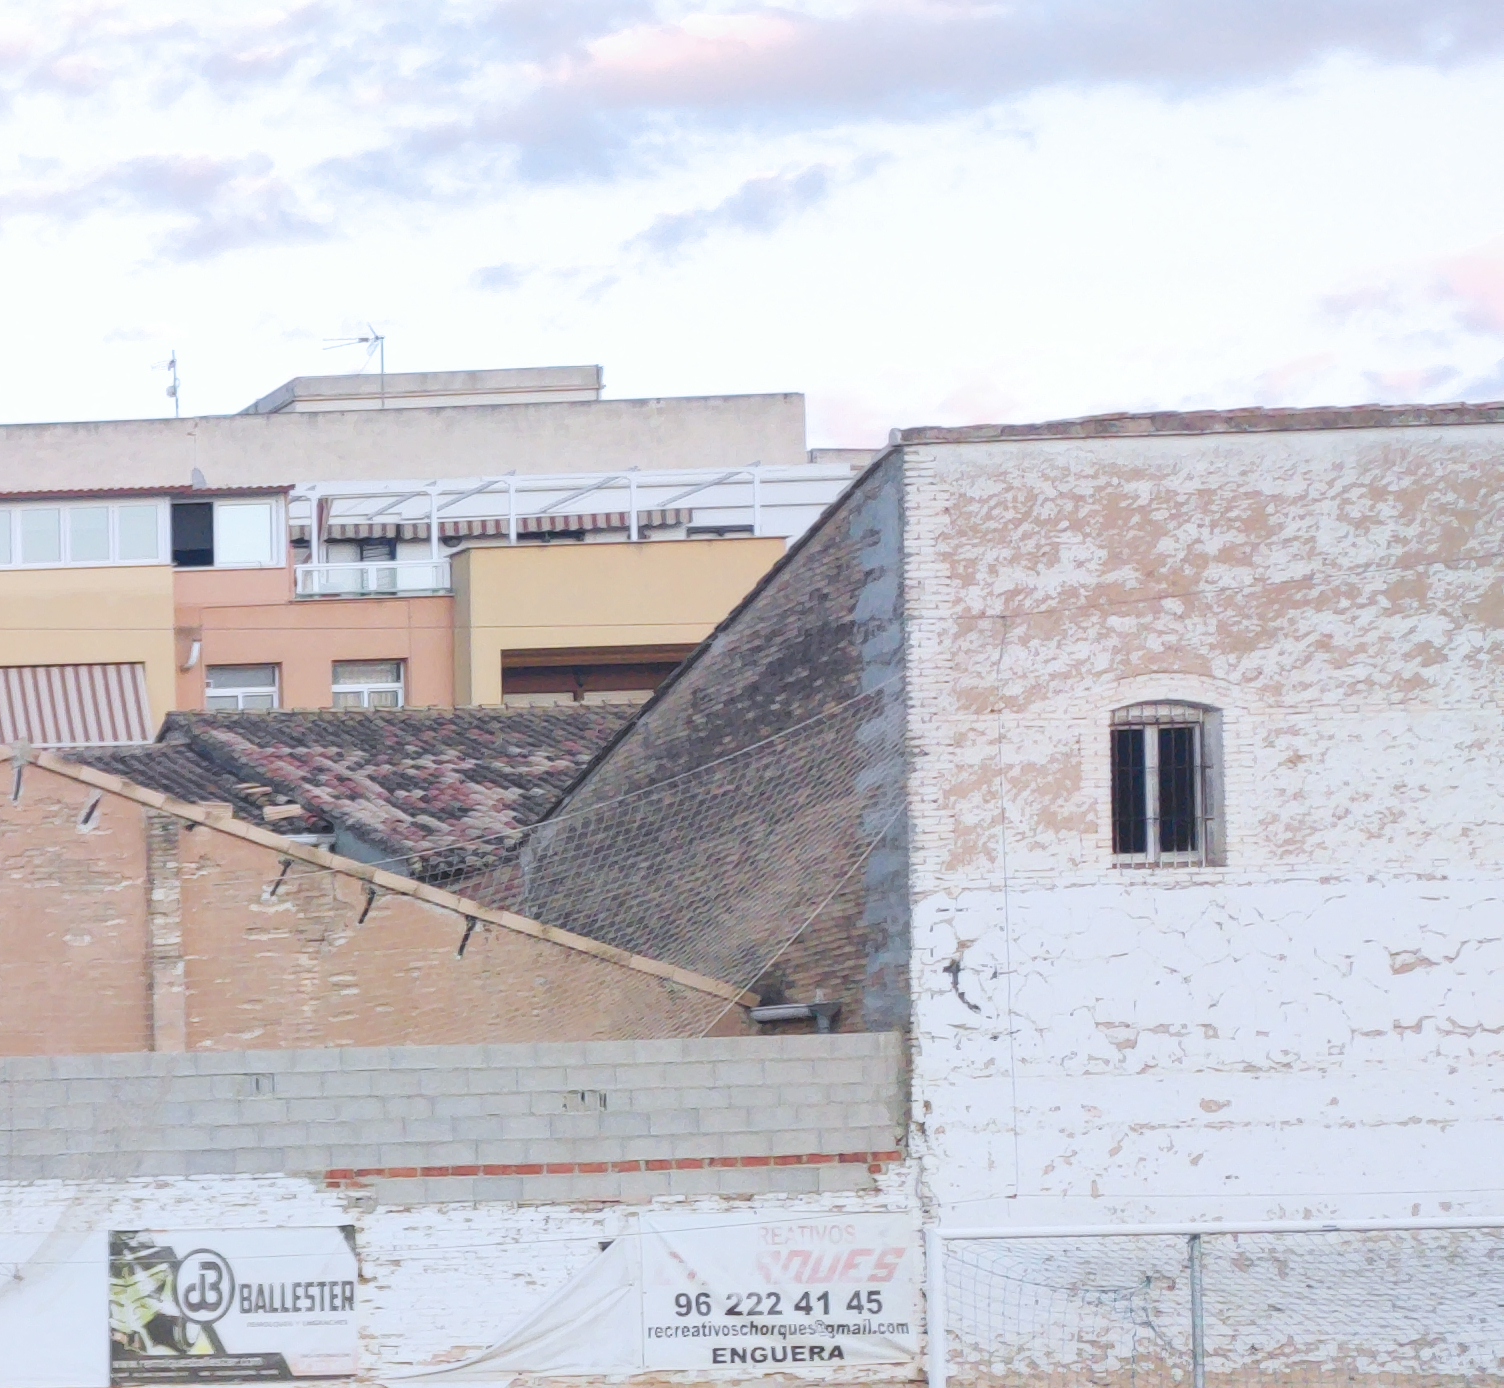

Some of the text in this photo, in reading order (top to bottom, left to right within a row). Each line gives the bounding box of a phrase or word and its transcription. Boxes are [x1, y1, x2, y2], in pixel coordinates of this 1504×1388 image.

[238, 1280, 356, 1314] BALLESTER
[674, 1289, 884, 1317] 96 222 41 45
[647, 1319, 910, 1341] recreativoschorques@gmail.com
[712, 1344, 846, 1364] ENGUERA
